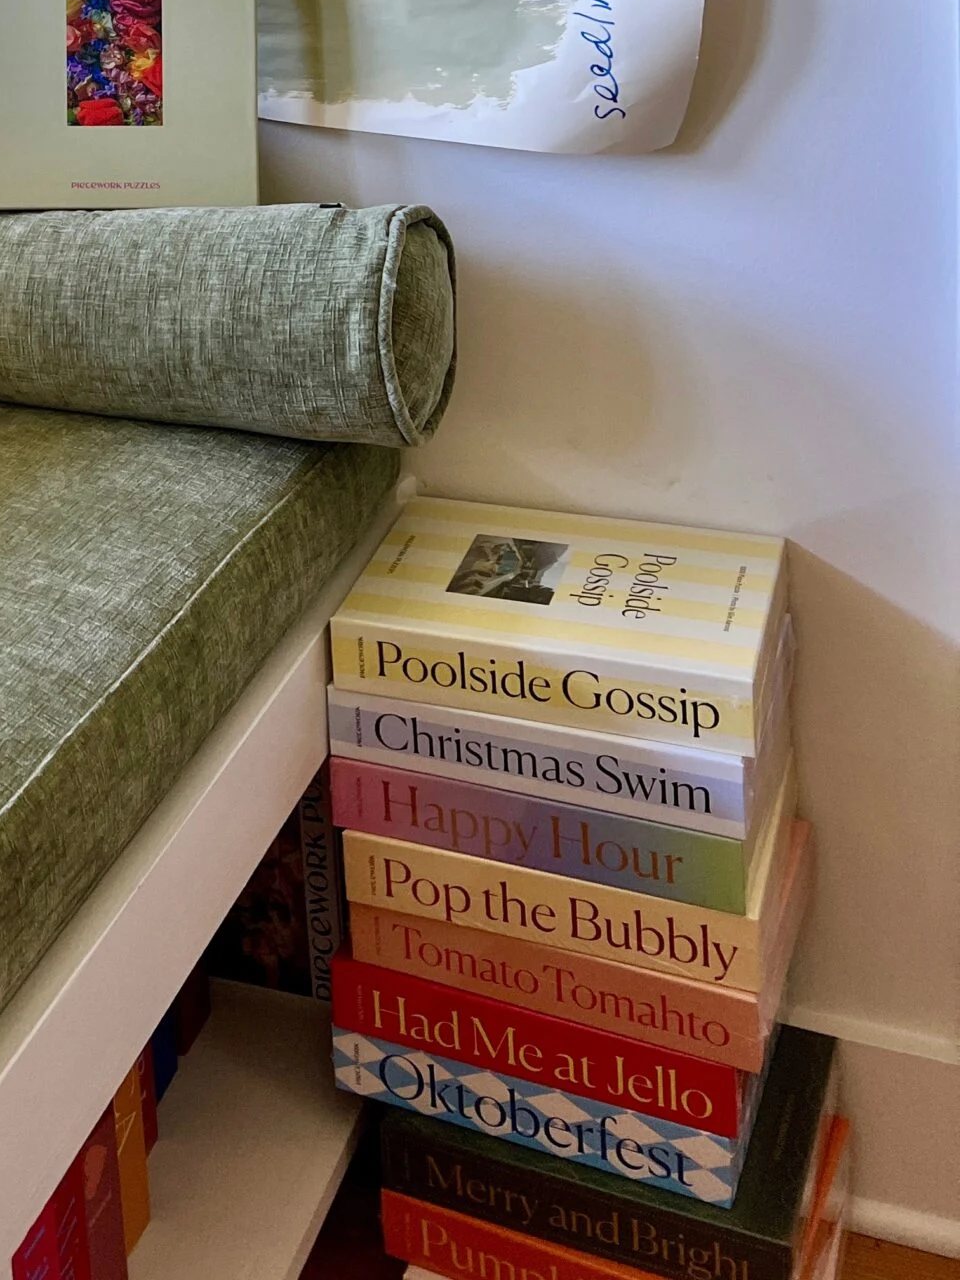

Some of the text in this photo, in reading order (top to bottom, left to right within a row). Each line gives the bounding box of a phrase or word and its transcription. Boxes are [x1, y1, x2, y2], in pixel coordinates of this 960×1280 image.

[569, 553, 629, 607] Gossip
[621, 552, 678, 619] Poolside
[376, 640, 720, 738] Poolside Gossip
[374, 713, 712, 814] Christmas Swim
[381, 780, 538, 862] Happy
[550, 815, 683, 885] Hour
[383, 858, 471, 922] Pop
[482, 881, 557, 933] the
[569, 896, 738, 981] Bubbly
[392, 923, 540, 995] Tomato
[542, 965, 730, 1047] Tomahto
[372, 989, 462, 1051] Had
[470, 1016, 543, 1072] Me
[553, 1053, 597, 1089] at
[606, 1055, 713, 1119] Jello
[378, 1053, 693, 1187] Oktoberfest
[426, 1153, 539, 1225] Merry
[548, 1204, 620, 1246] and
